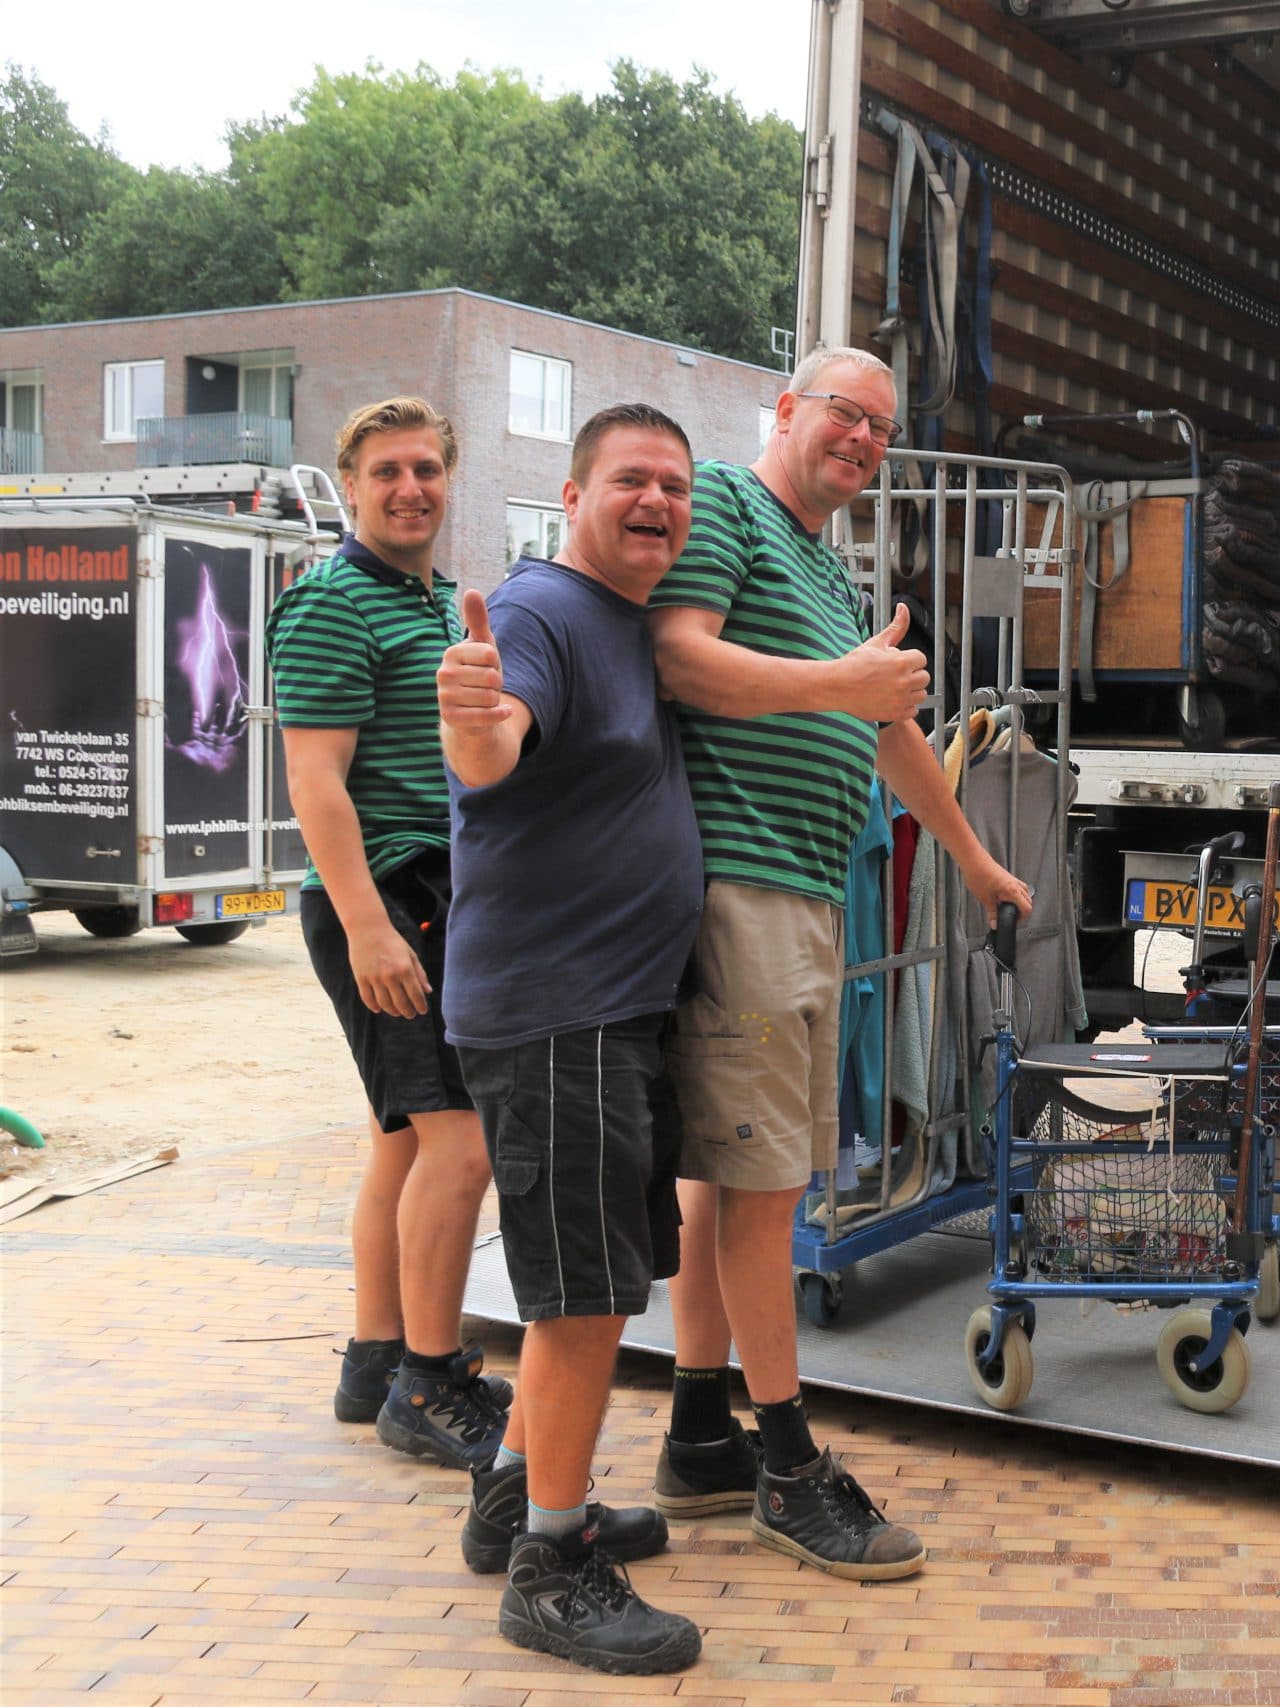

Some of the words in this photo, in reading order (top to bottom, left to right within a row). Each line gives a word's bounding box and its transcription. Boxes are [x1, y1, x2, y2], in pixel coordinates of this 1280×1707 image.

[0, 551, 21, 581] n
[27, 544, 128, 581] Holland
[16, 731, 38, 743] van
[40, 730, 112, 746] Twickelolaan
[114, 733, 129, 746] 35
[16, 747, 42, 760] 7742
[44, 748, 64, 761] WS
[66, 749, 129, 763] Coevorden
[58, 783, 129, 798] 06-29237837
[1129, 904, 1142, 915] NL
